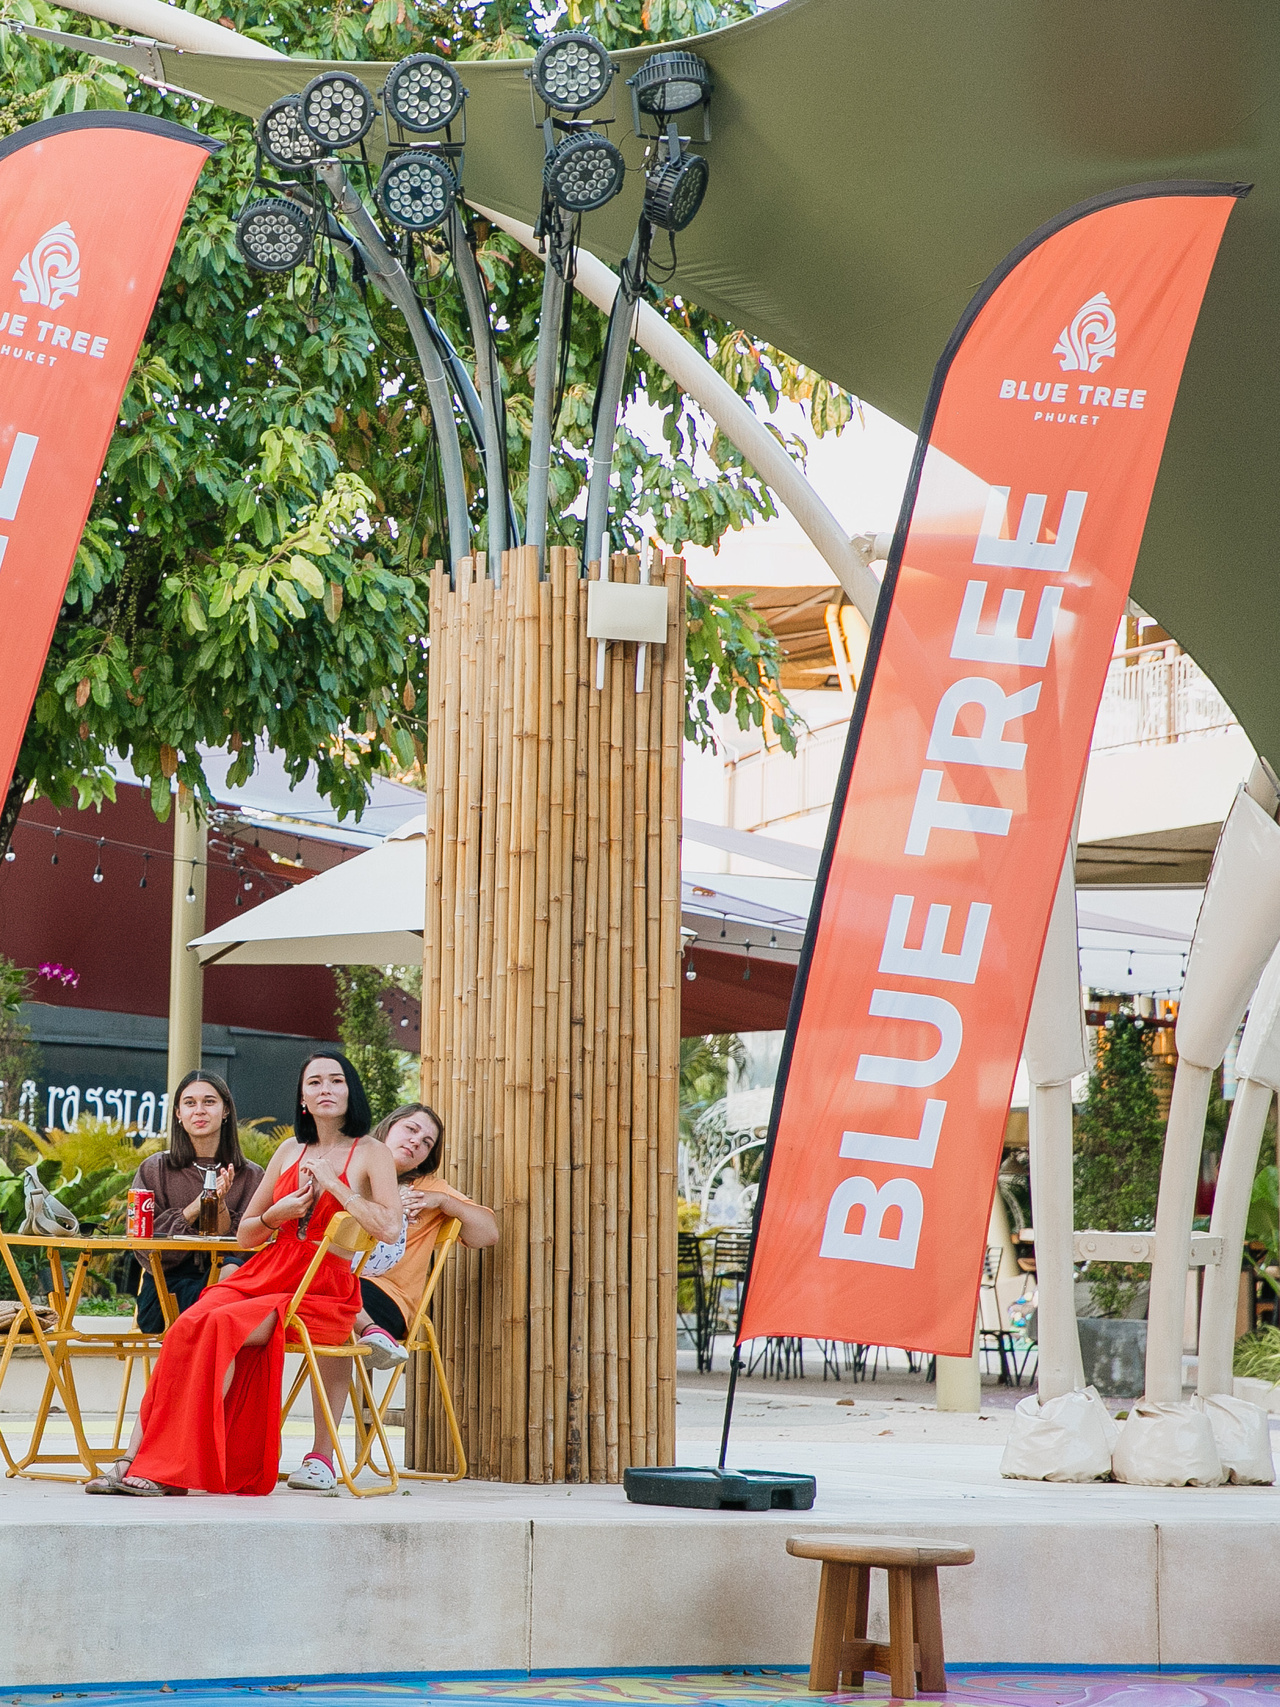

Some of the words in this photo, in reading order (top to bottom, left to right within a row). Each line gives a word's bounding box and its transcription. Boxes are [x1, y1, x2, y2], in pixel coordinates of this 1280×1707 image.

[37, 320, 109, 359] TREE
[999, 379, 1069, 404] BLUE
[1077, 384, 1148, 410] TREE
[1033, 411, 1100, 426] PHUKET
[903, 484, 1089, 857] TREE
[818, 893, 993, 1271] BLUE
